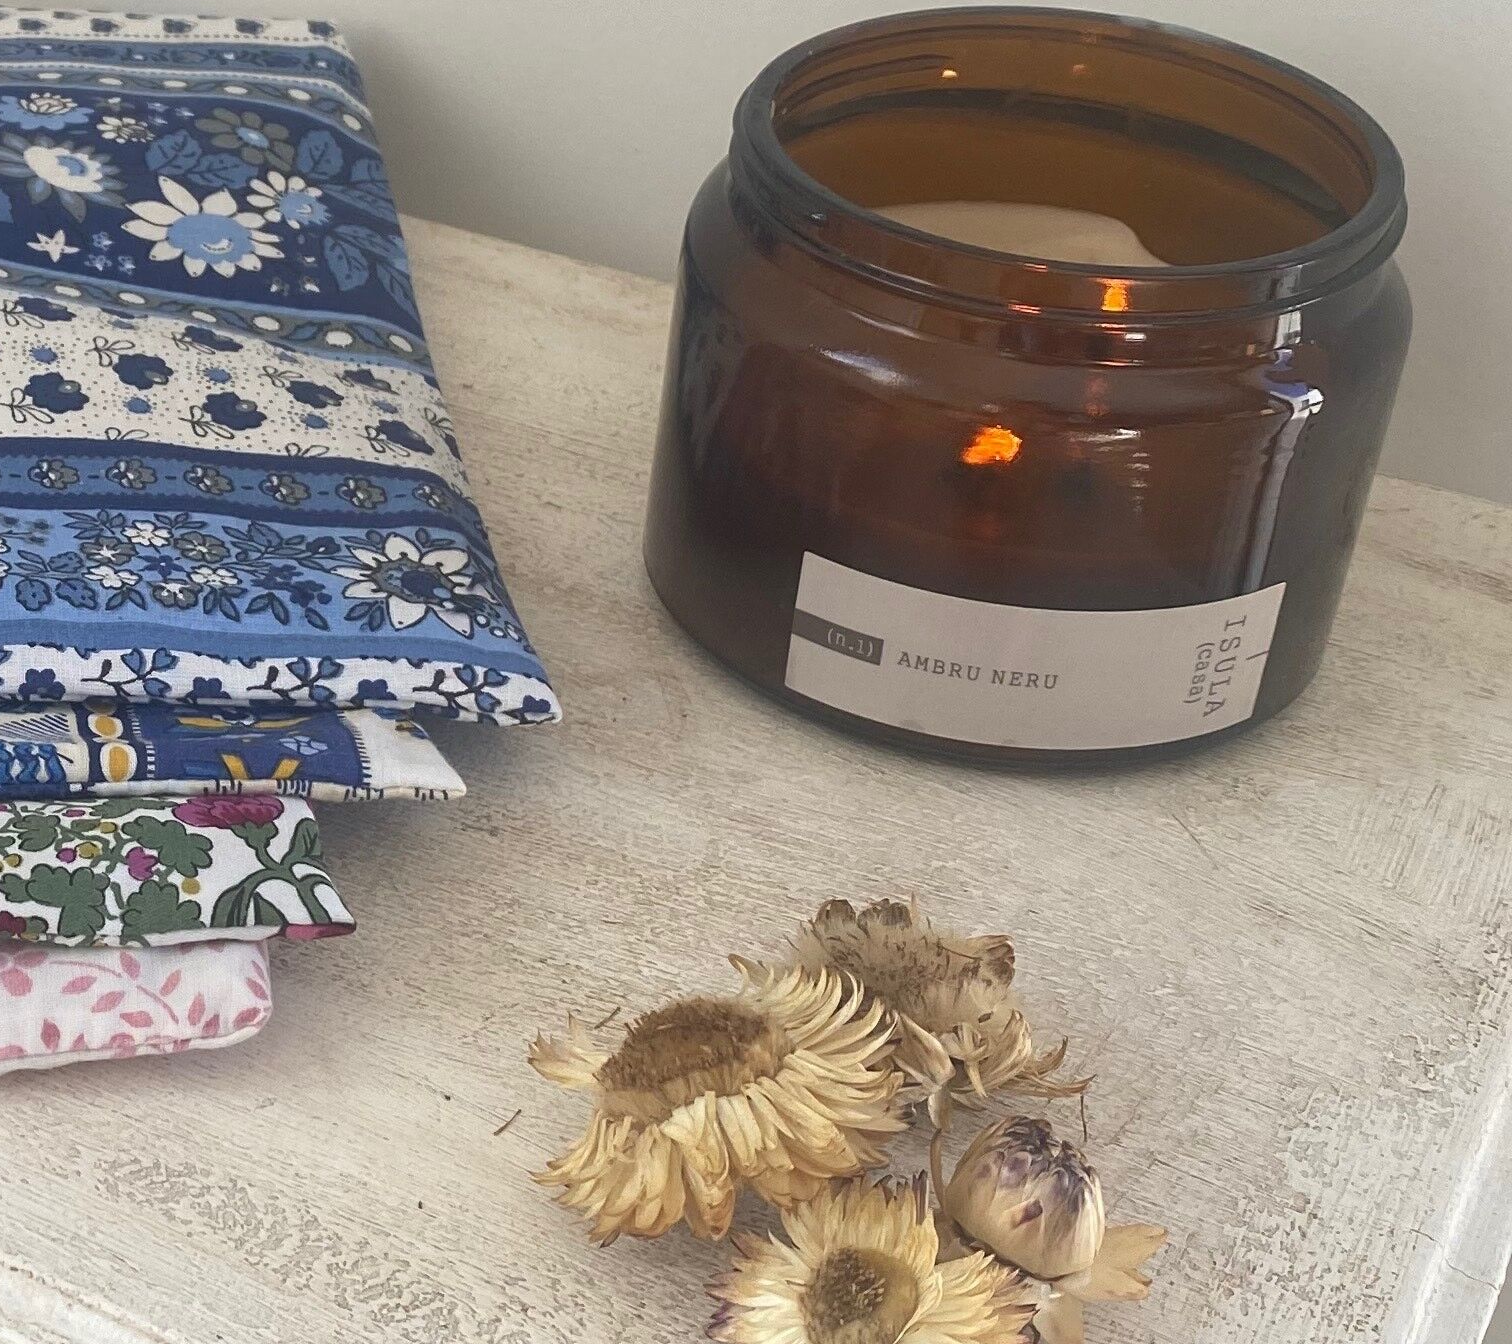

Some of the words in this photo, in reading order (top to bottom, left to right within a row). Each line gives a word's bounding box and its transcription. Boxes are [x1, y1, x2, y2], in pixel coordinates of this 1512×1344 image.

[897, 651, 981, 682] AMBRU
[991, 669, 1059, 690] NERU
[1183, 642, 1216, 704] (casa)
[1202, 614, 1248, 718] ISULA
